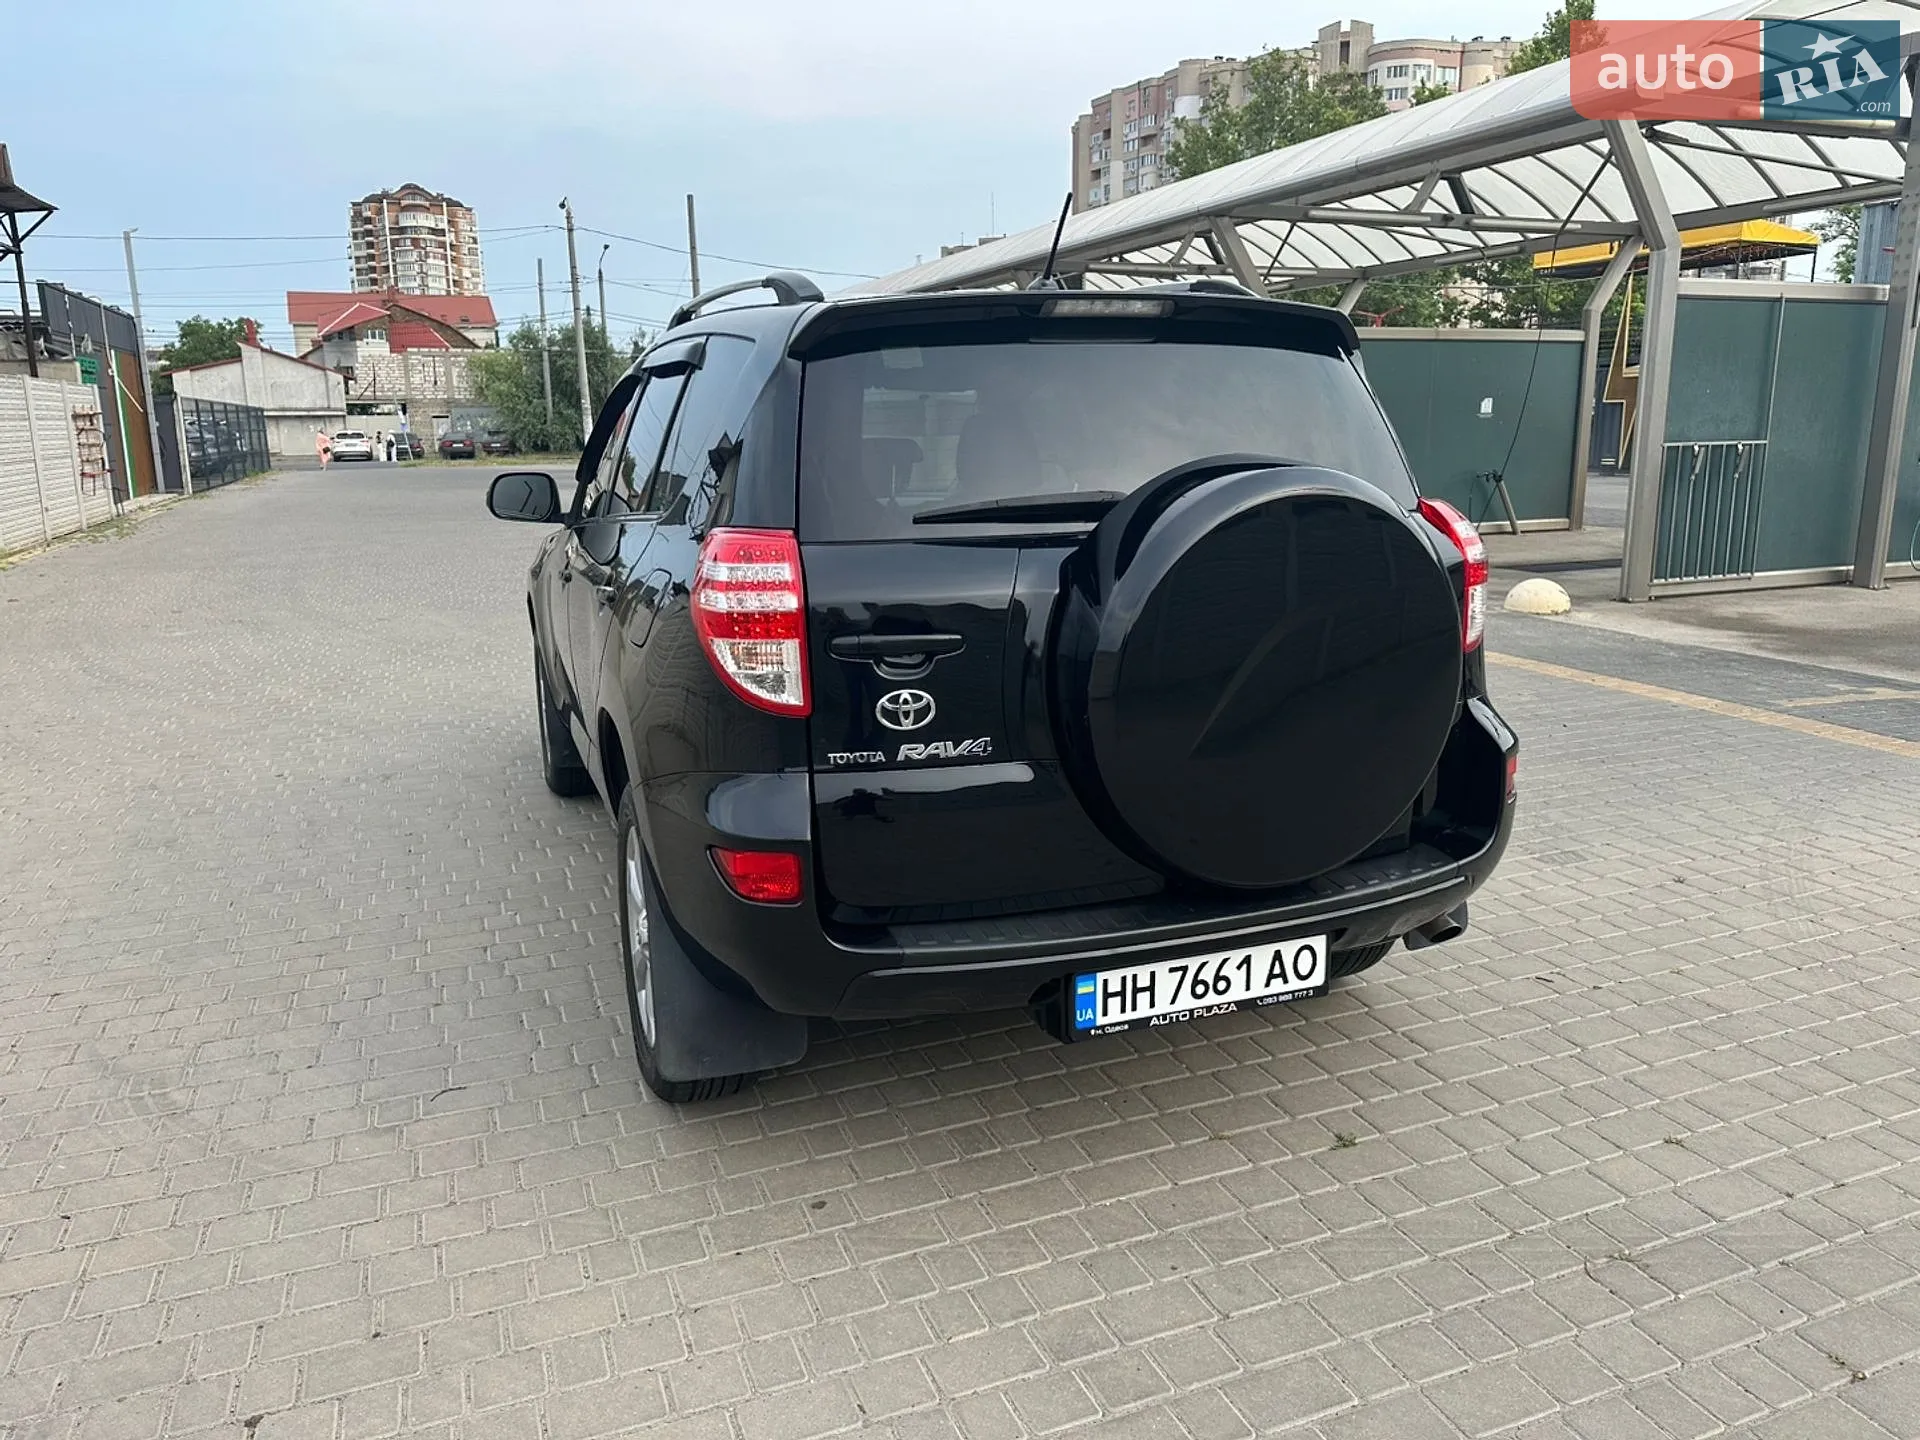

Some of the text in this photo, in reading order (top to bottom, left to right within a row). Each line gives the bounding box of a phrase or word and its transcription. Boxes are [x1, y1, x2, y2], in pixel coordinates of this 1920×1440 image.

[827, 737, 993, 765] TOYOTA RAV4
[1101, 943, 1318, 1018] HH 7661 AO
[1076, 1007, 1095, 1022] UA
[1149, 1002, 1238, 1027] AUTO PLAZA
